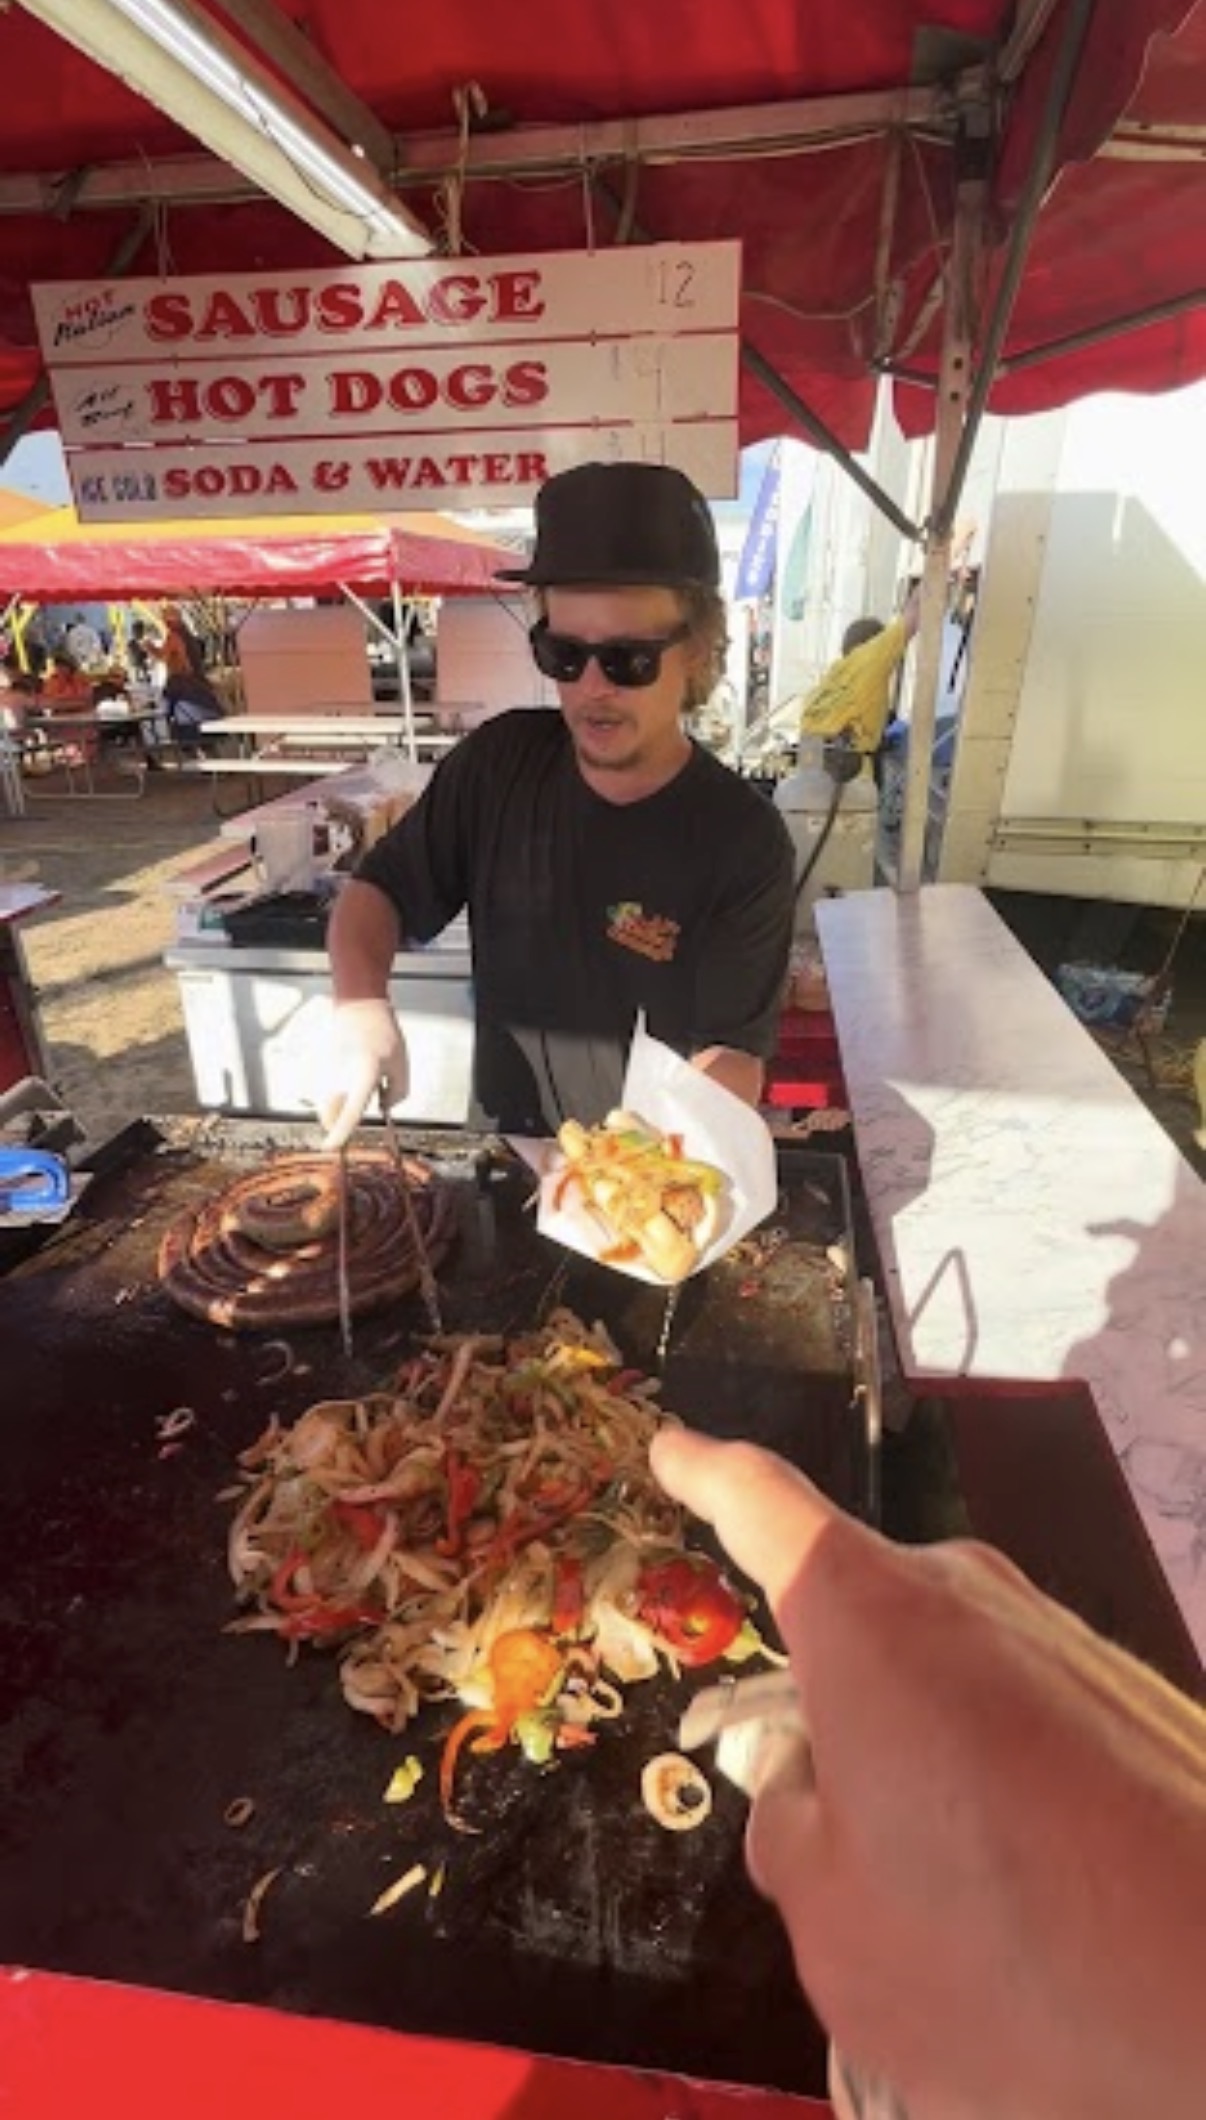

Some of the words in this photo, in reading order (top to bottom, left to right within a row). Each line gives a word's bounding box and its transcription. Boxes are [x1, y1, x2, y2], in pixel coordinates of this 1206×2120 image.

[144, 270, 546, 342] SAUSAGE
[147, 374, 306, 425] HOT
[325, 361, 549, 419] DOGS
[162, 462, 298, 498] SODA
[312, 460, 352, 491] &
[365, 451, 549, 490] WATER
